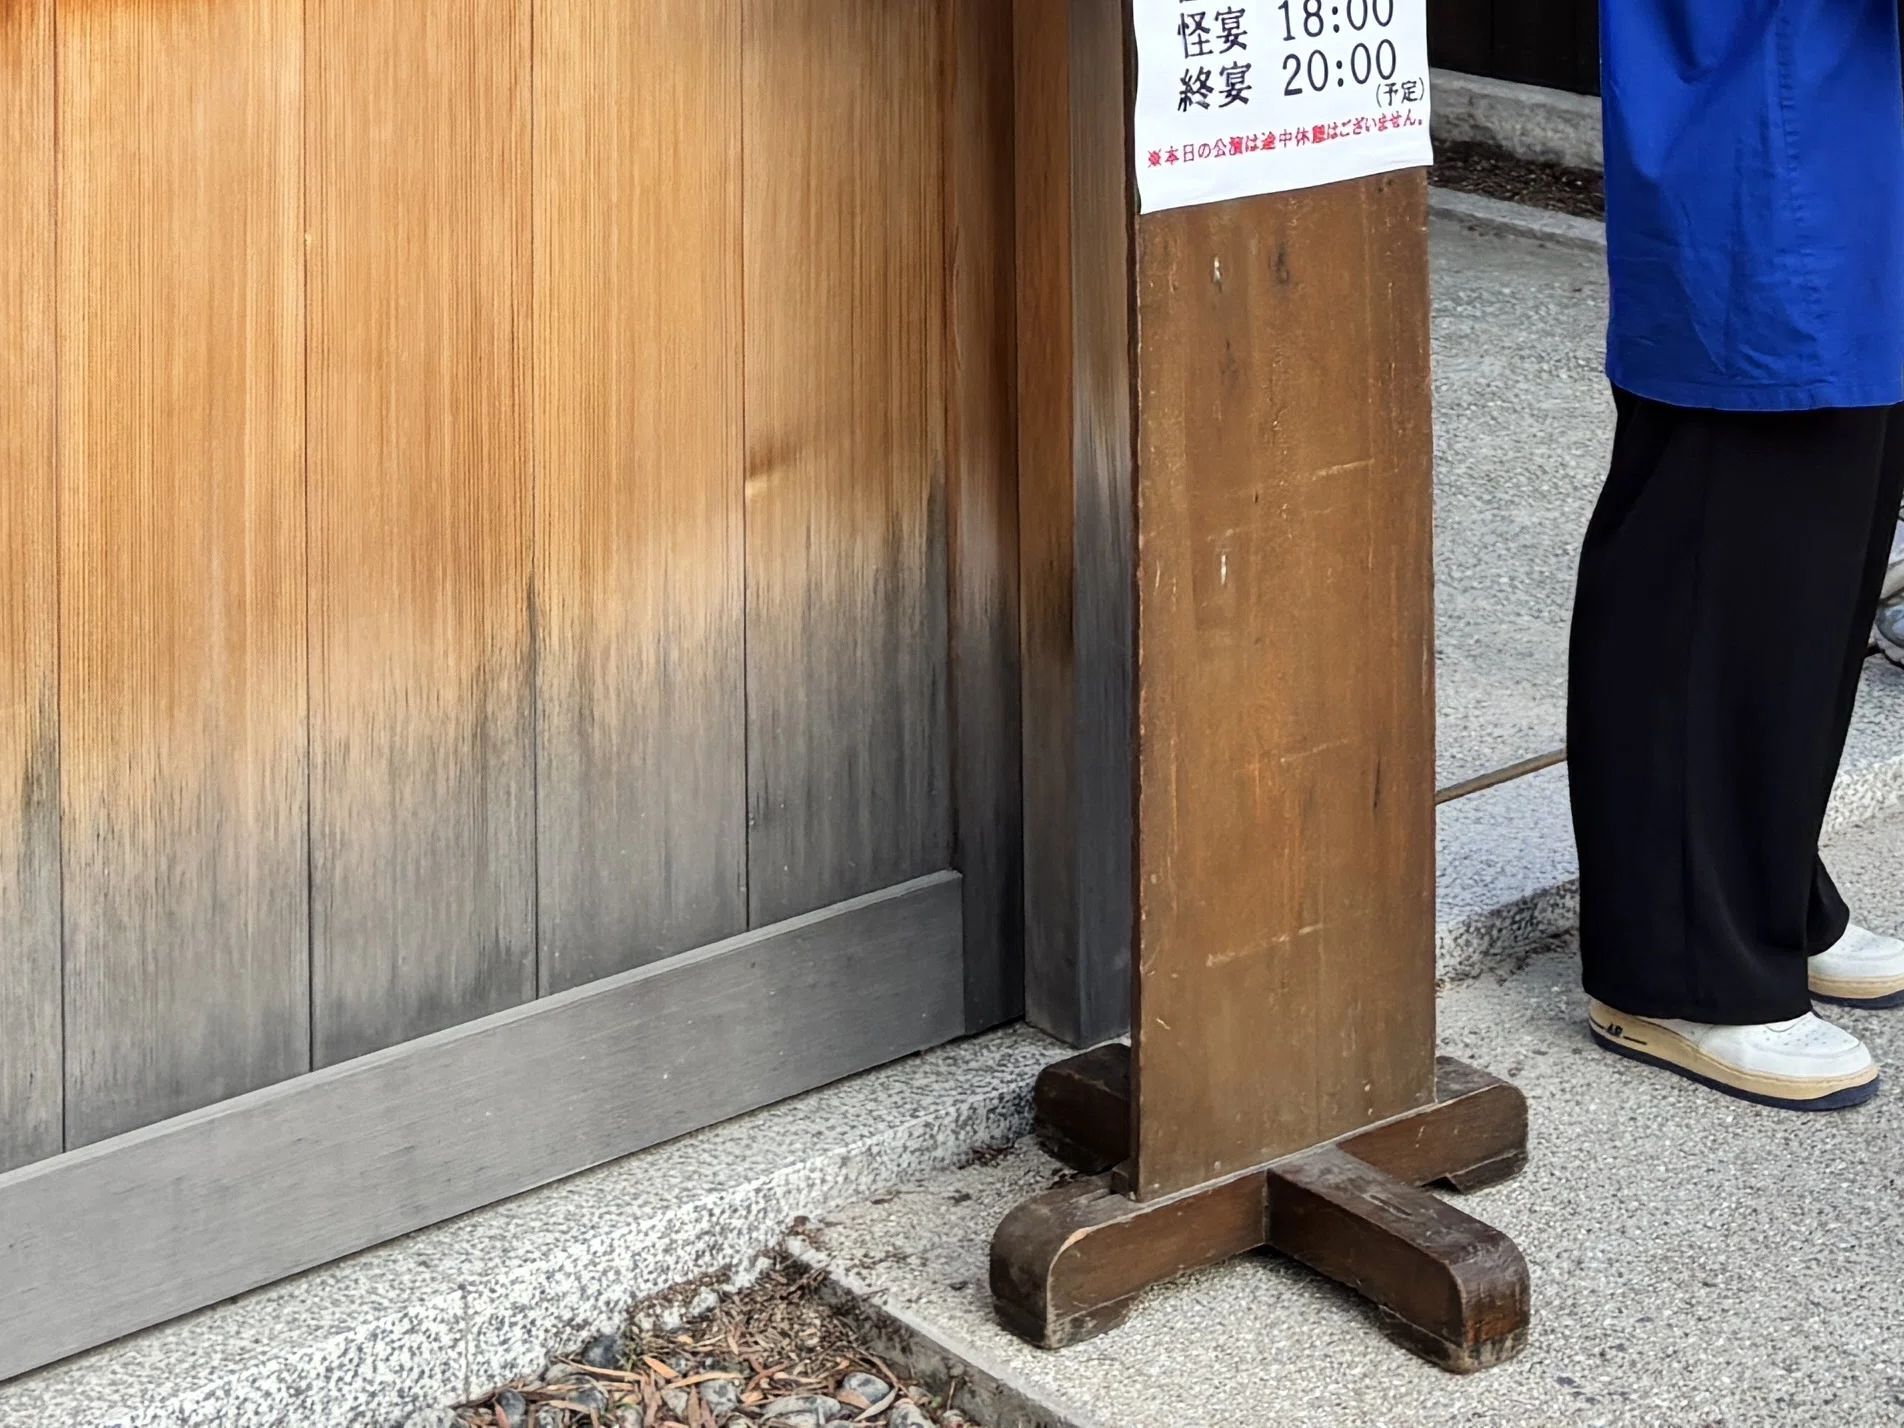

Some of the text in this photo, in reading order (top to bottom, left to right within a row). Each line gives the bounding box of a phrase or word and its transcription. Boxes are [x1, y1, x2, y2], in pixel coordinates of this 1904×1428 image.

[1177, 5, 1248, 59] 怪宴
[1178, 38, 1397, 112] 終宴 20:00
[1376, 77, 1425, 108] (予定)
